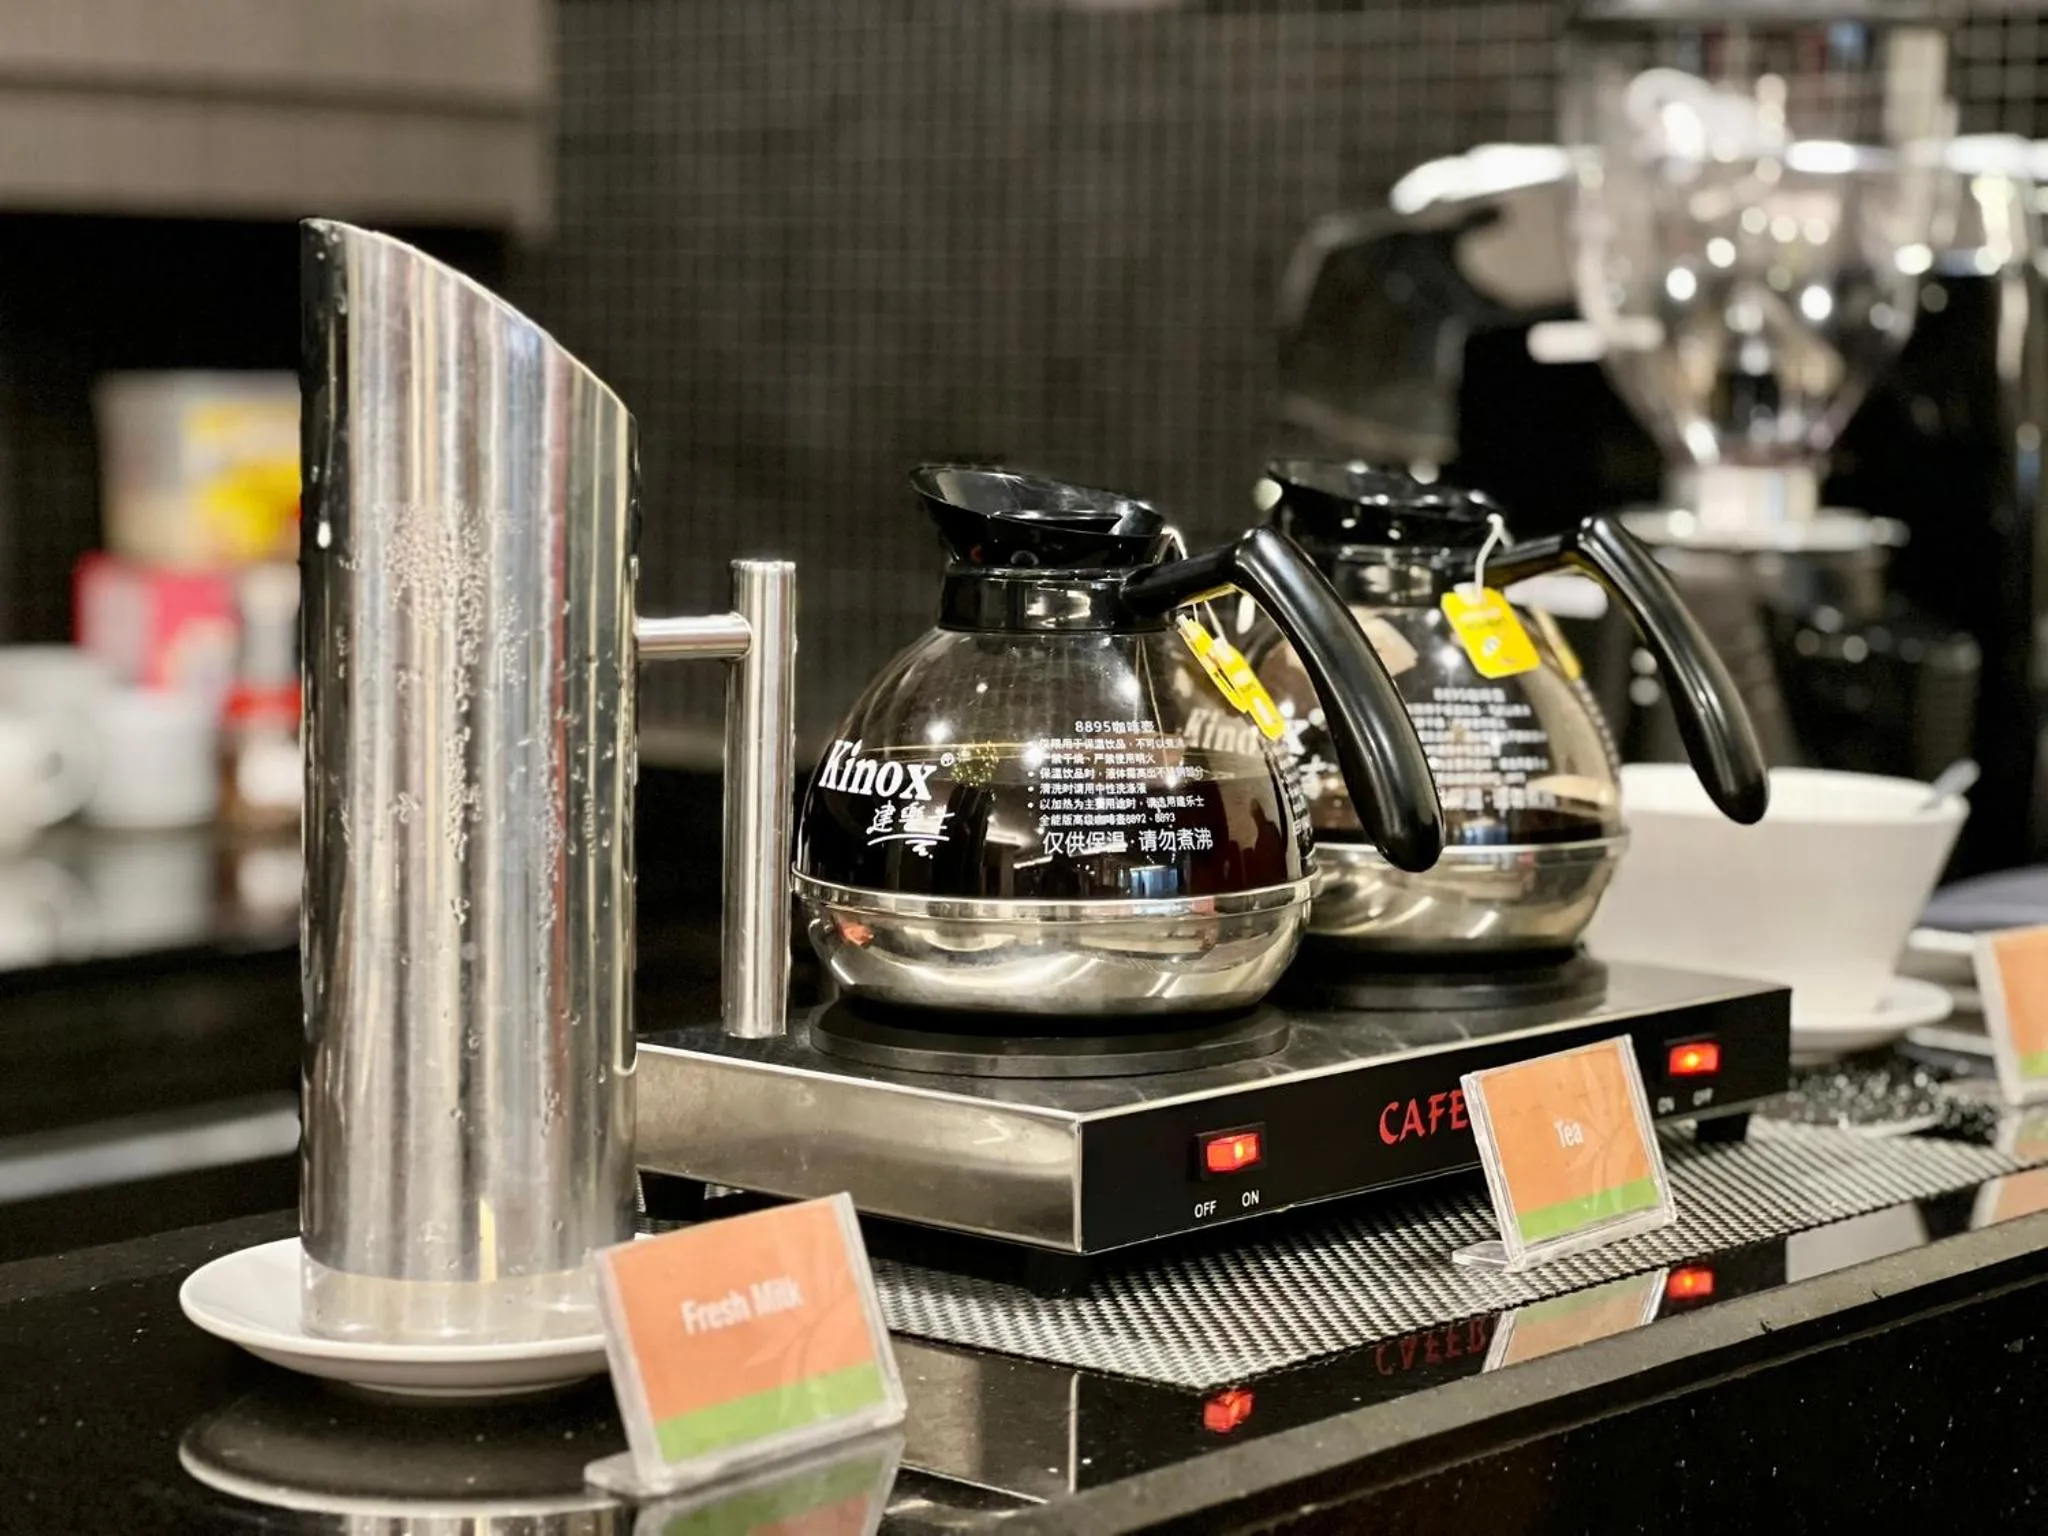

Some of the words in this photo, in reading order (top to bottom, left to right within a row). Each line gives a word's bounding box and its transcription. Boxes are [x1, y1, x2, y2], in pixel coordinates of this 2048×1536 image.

[818, 739, 938, 801] Kinox
[1553, 1118, 1584, 1148] Tea
[1194, 1200, 1217, 1218] OFF
[1241, 1189, 1260, 1207] ON
[681, 1289, 752, 1336] Fresh
[750, 1277, 805, 1317] Milk
